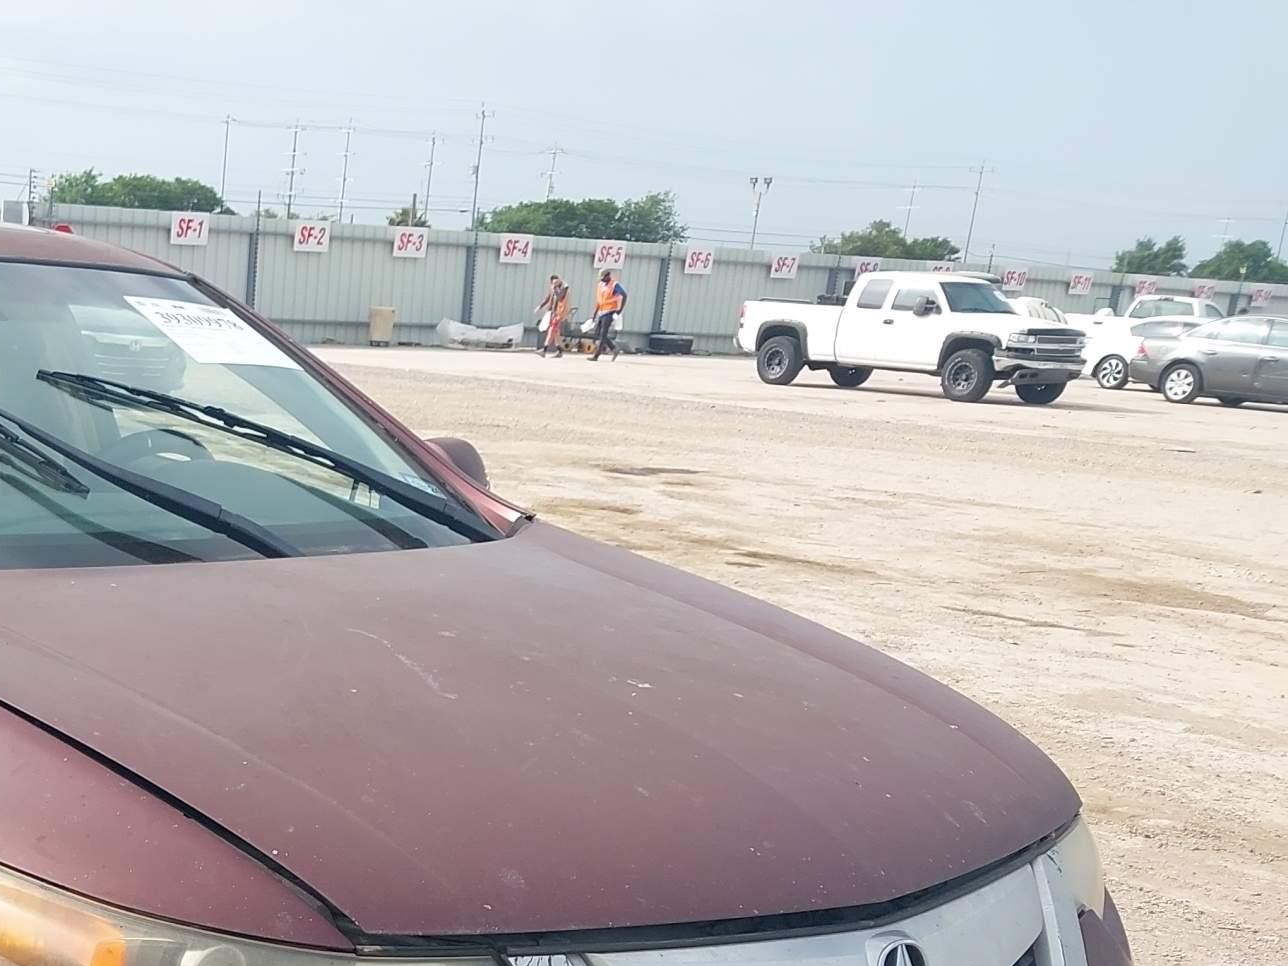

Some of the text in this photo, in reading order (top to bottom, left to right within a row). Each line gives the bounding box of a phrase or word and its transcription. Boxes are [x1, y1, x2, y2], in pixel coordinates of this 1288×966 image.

[177, 218, 203, 239] SF-1
[299, 225, 326, 246] SF-2
[398, 232, 424, 251] SF-3
[504, 239, 529, 257] SF-4
[598, 245, 621, 263] SF-5
[688, 251, 710, 269] SF-6
[774, 257, 796, 273] SF-7
[1003, 270, 1027, 286] SF-10
